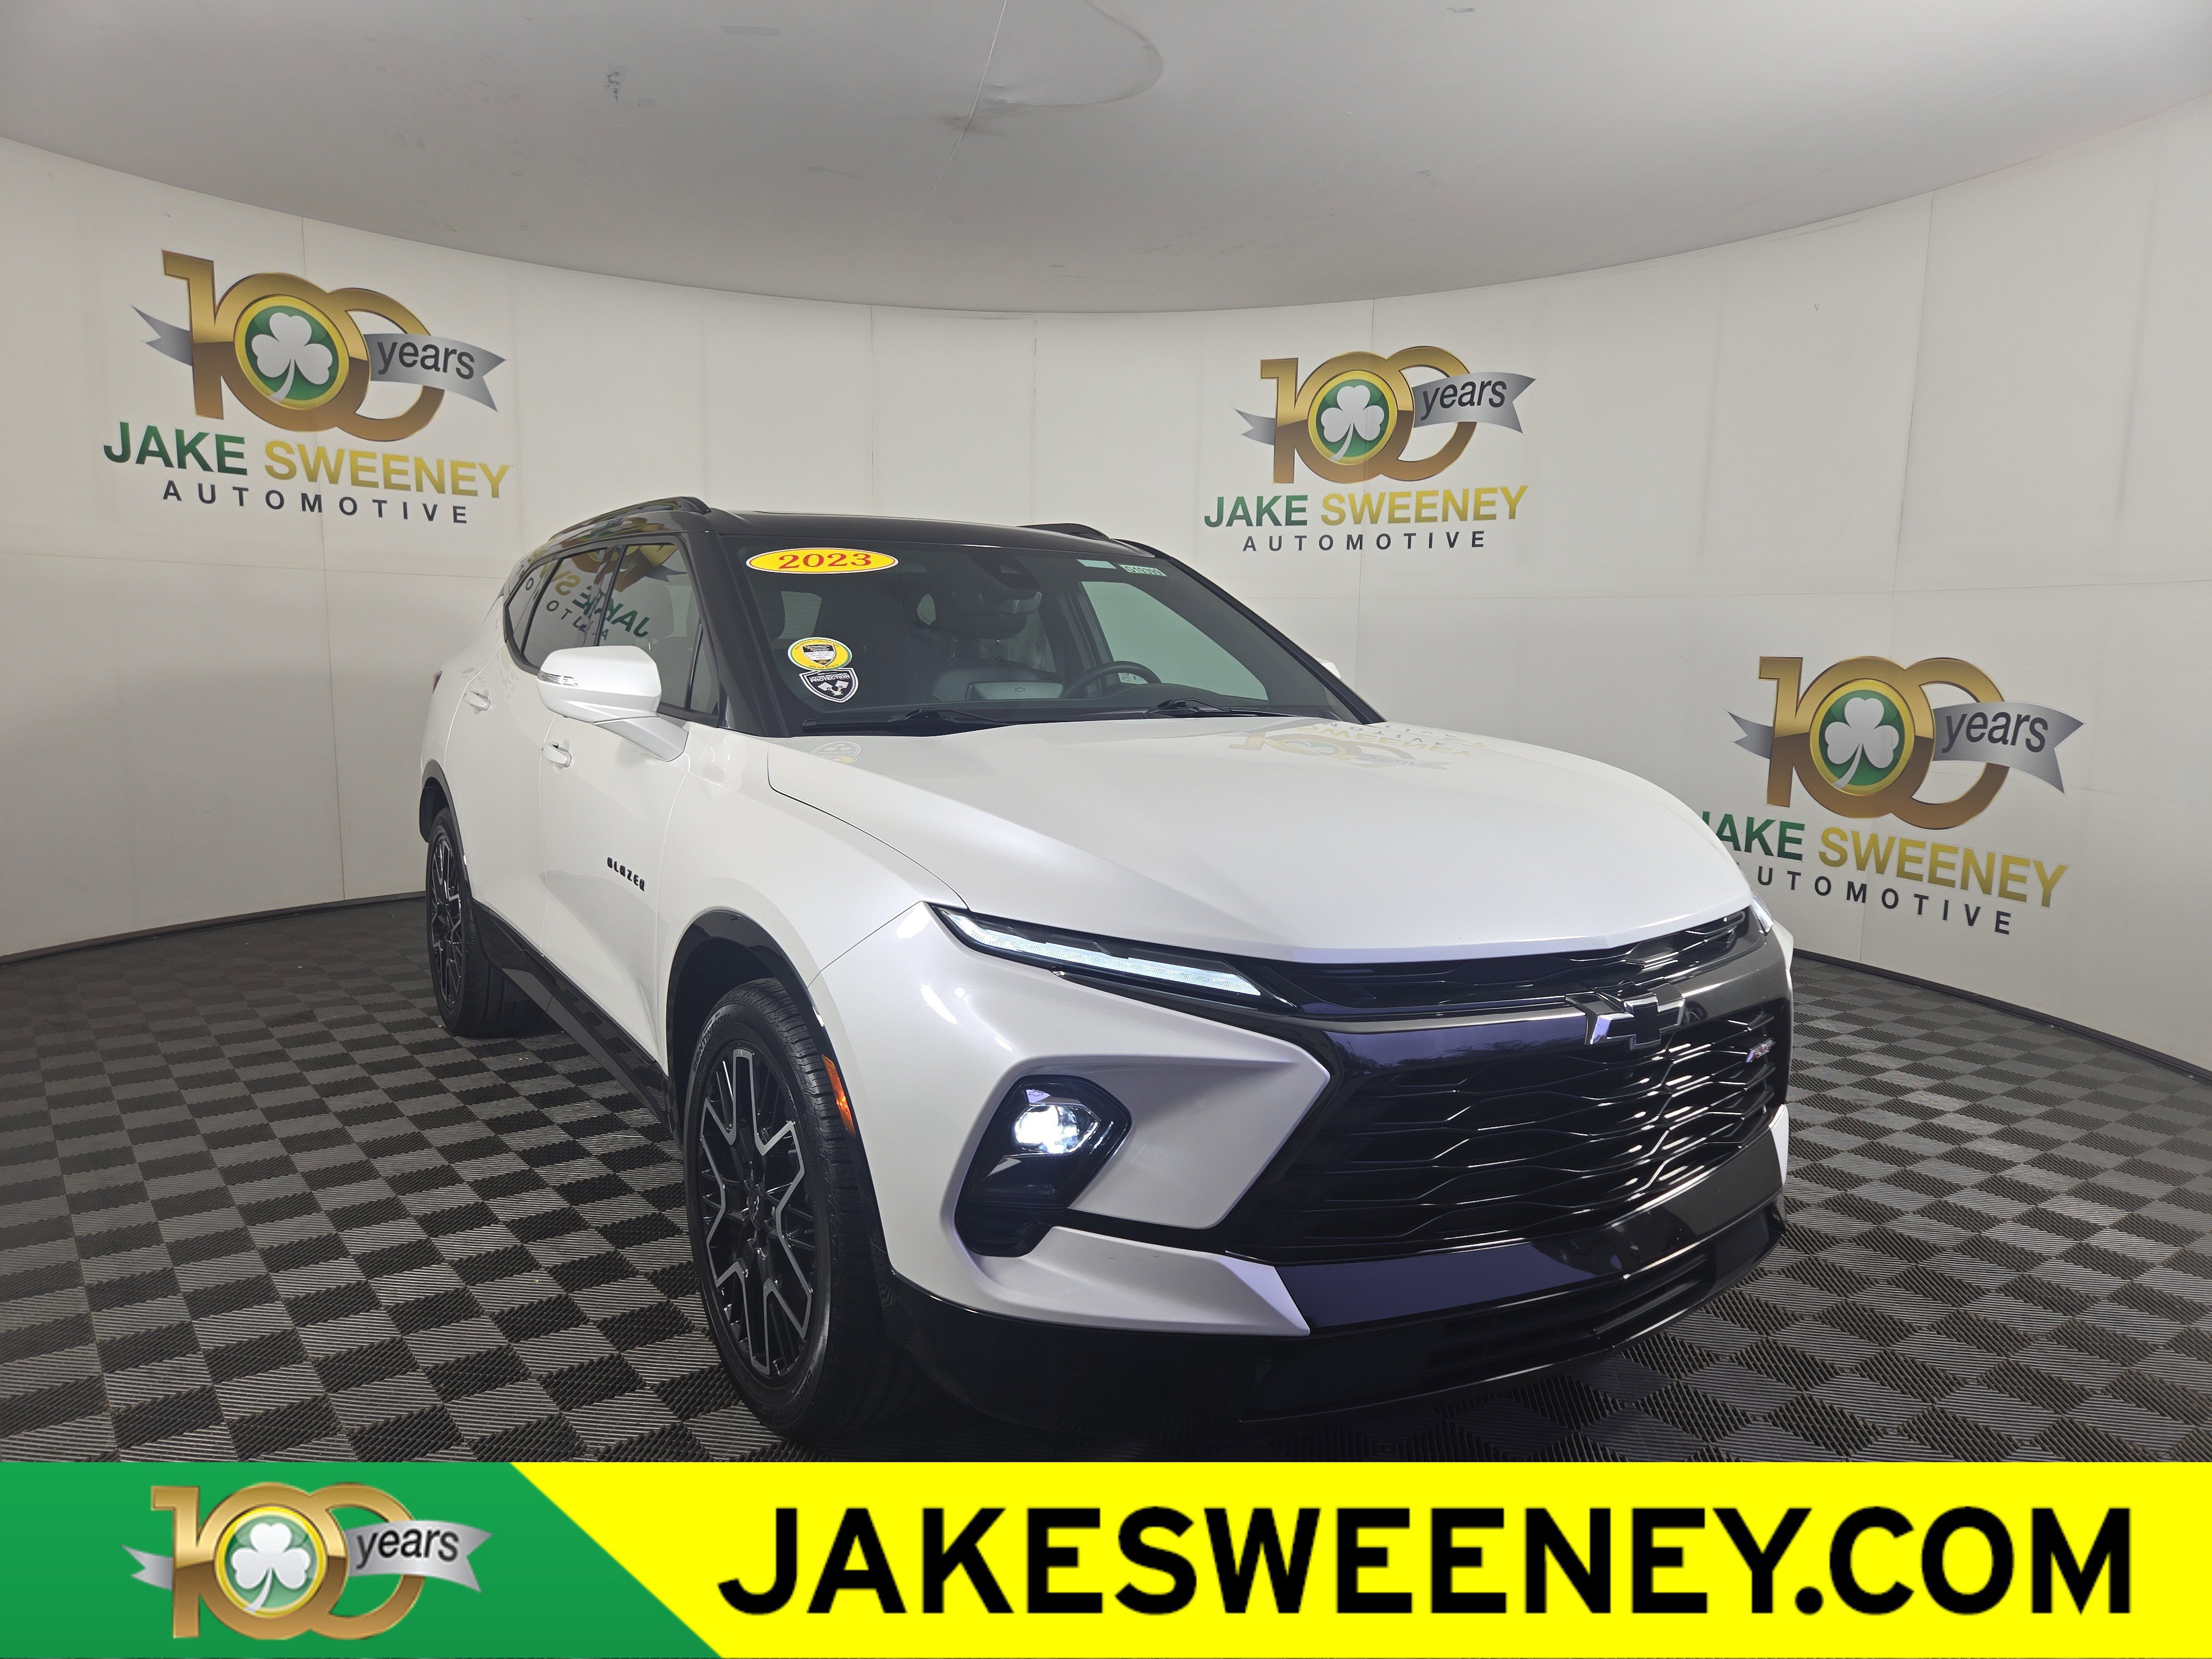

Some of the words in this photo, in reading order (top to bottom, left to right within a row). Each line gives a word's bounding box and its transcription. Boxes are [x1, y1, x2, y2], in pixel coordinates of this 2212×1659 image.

[161, 249, 445, 442] 100
[376, 337, 475, 381] years
[1260, 345, 1477, 484] 100
[1420, 379, 1507, 421] years
[103, 421, 248, 477] JAKE
[264, 440, 512, 499] SWEENEY
[163, 480, 467, 525] AUTOMOTIVE
[1204, 494, 1308, 528] JAKE
[1321, 485, 1529, 526] SWEENEY
[778, 553, 871, 569] 2023
[1242, 531, 1484, 552] AUTOMOTIVE
[810, 674, 851, 683] PROTECTION
[1759, 655, 2010, 829] 100
[1941, 710, 2048, 754] years
[607, 857, 645, 892] BLAZER
[1818, 827, 2068, 908] SWEENEY
[1737, 862, 2011, 935] UTOMOTIVE
